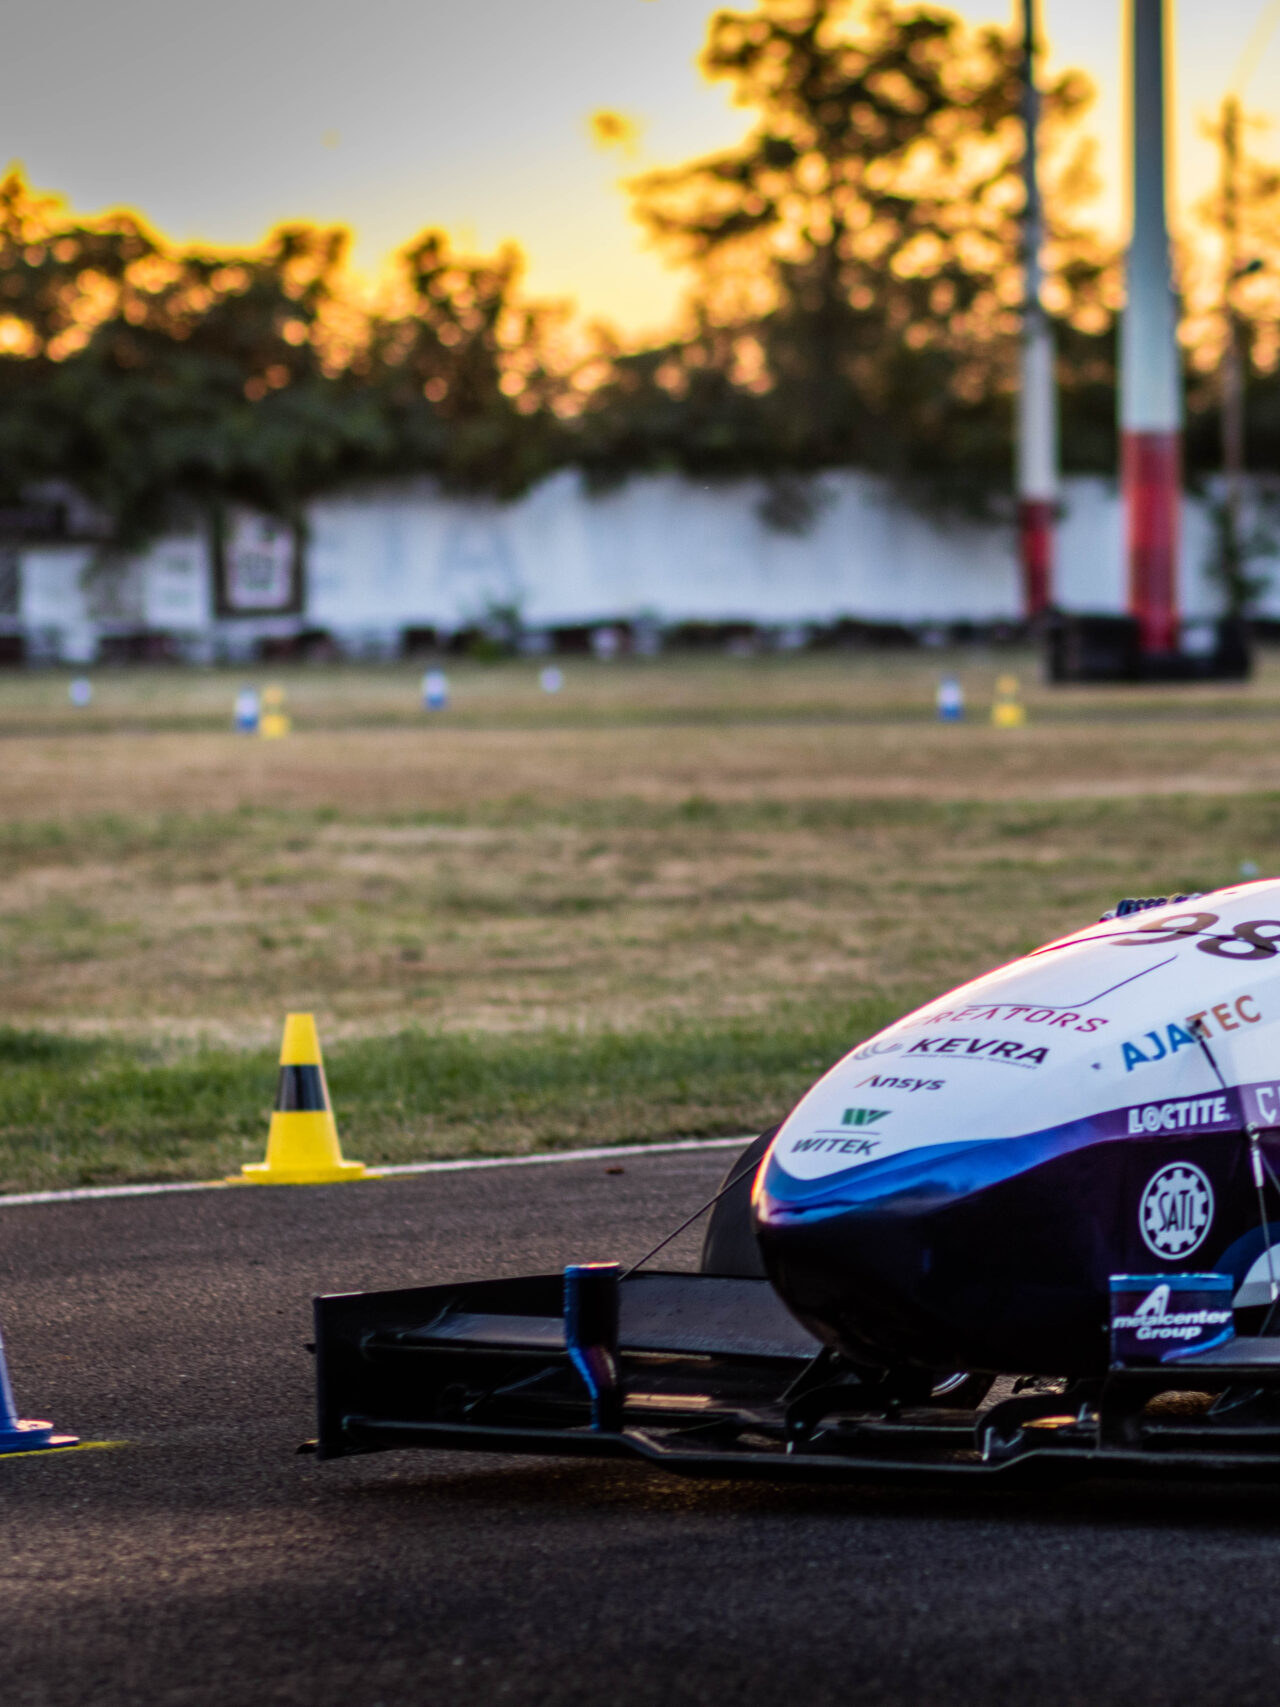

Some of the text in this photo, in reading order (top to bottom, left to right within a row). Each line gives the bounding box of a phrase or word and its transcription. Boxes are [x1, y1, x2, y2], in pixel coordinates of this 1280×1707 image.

[1121, 995, 1262, 1073] AJATEC
[906, 1037, 1050, 1065] KEVRA
[854, 1074, 946, 1092] Ansys
[1128, 1095, 1229, 1134] LOCTITE
[790, 1137, 882, 1156] WITEK
[1136, 1325, 1203, 1341] Group
